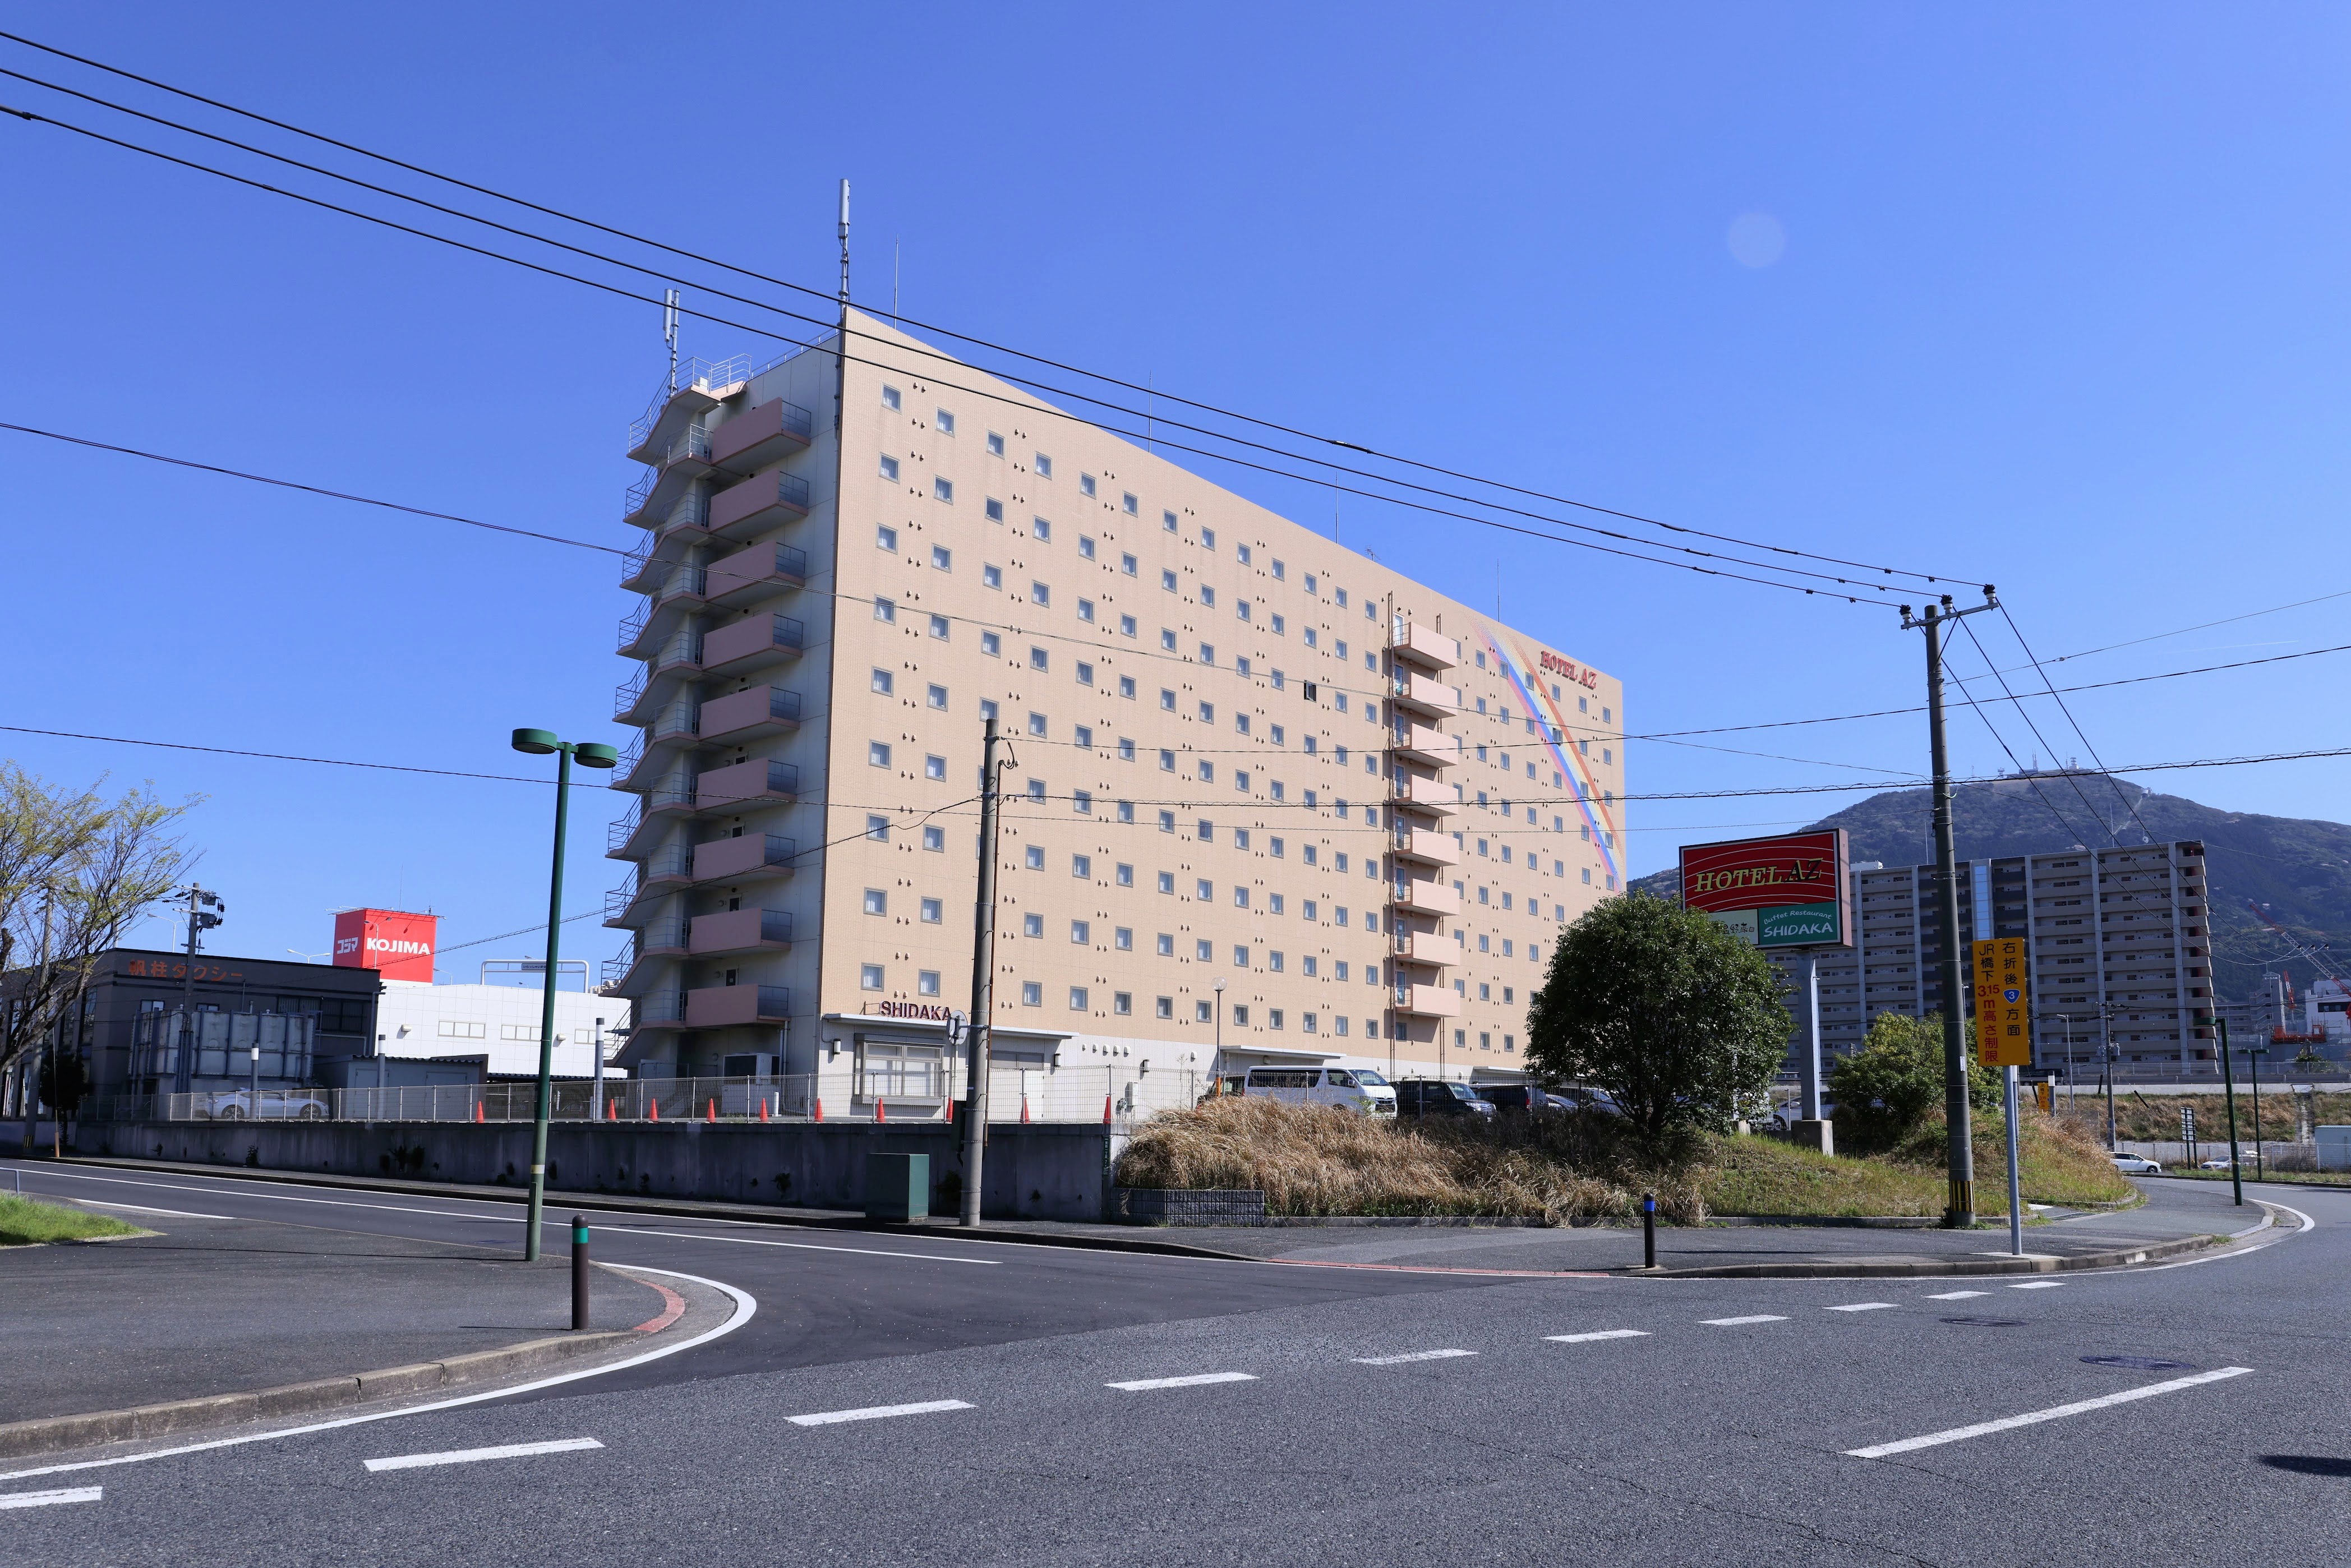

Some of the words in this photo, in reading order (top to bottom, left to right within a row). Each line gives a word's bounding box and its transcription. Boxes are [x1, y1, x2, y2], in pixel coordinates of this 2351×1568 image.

[1540, 651, 1578, 682] HOTEL
[1579, 668, 1597, 690] AZ
[1694, 865, 1782, 892] HOTEL
[1784, 857, 1823, 883] AZ
[1764, 912, 1788, 925] Buffet
[1790, 910, 1832, 919] Restaurant
[1763, 922, 1833, 937] SHIDAKA
[337, 937, 358, 954] コジマ
[366, 937, 430, 955] KOJIMA
[2002, 942, 2017, 985] 右折後
[879, 1000, 951, 1021] SHIDAKA
[2006, 1008, 2020, 1035] 方面
